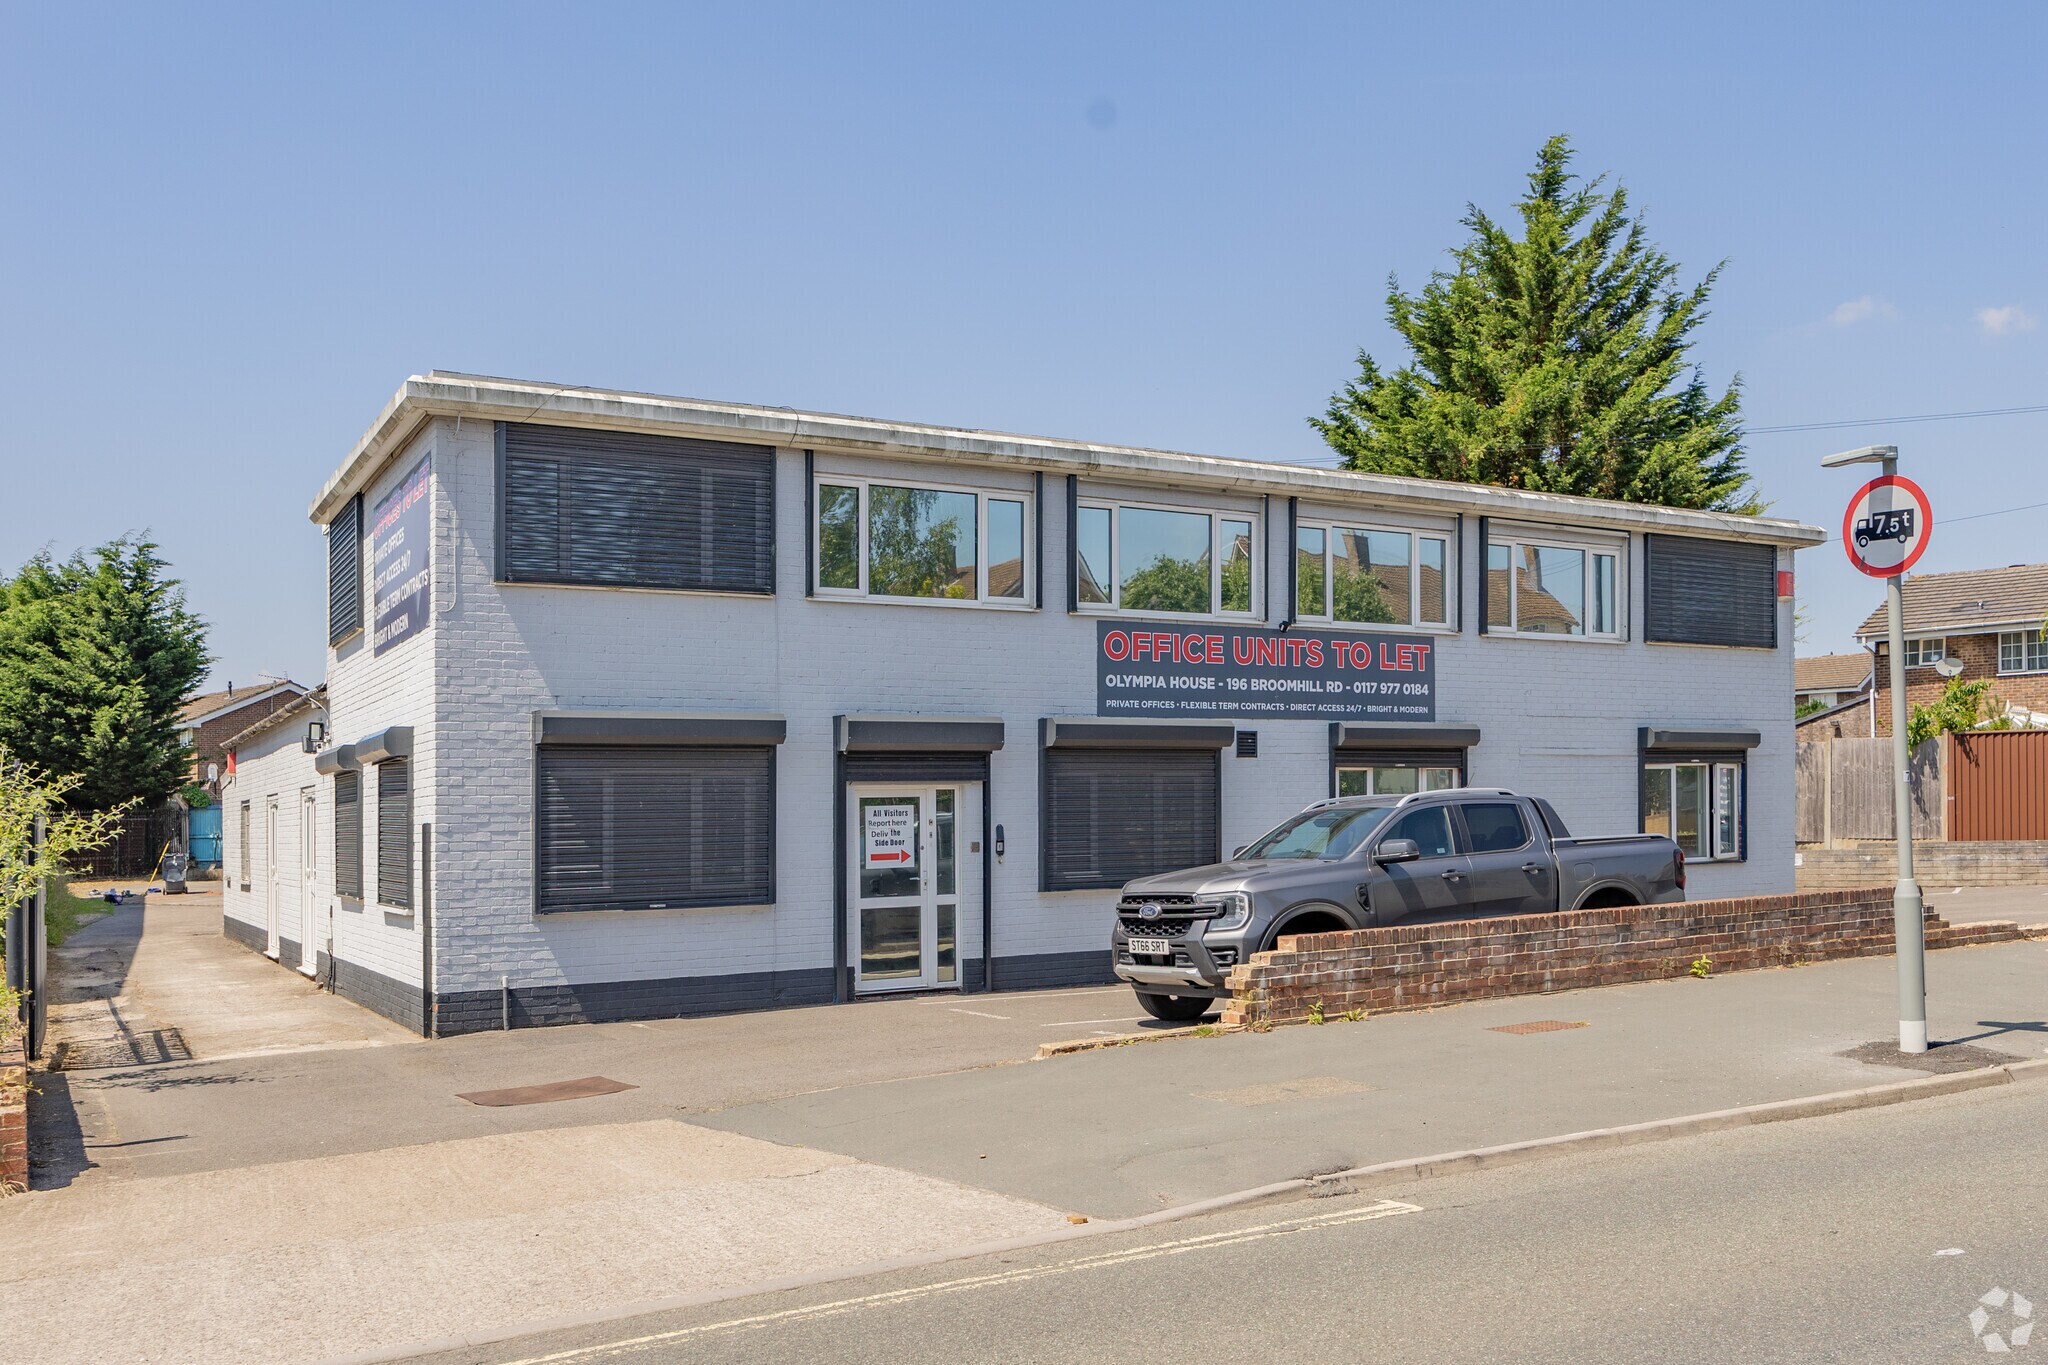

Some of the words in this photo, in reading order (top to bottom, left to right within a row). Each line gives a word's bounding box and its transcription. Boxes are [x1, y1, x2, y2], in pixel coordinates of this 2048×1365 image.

[388, 526, 404, 553] OFFICES
[386, 558, 400, 584] ACCESS
[401, 549, 411, 572] 24/7
[390, 587, 400, 609] TERM
[400, 568, 429, 601] CONTRACTS
[391, 612, 409, 639] MODERN
[1103, 630, 1224, 664] OFFICE
[1232, 635, 1324, 668] UNITS
[1331, 640, 1372, 669] TO
[1379, 642, 1430, 671] LET
[1105, 674, 1166, 689] OLYMPIA
[1169, 675, 1215, 690] HOUSE
[1226, 677, 1247, 691] 196
[1250, 678, 1323, 693] BROOMHILL
[1326, 680, 1342, 693] RD
[1353, 681, 1376, 694] 0117
[1380, 682, 1400, 694] 977
[1403, 682, 1428, 695] 0184
[1105, 699, 1139, 708] PRIVATE
[1141, 700, 1174, 709] OFFICES
[1181, 700, 1216, 709] FLEXIBLE
[1218, 701, 1238, 710] TERM
[1240, 702, 1284, 711] CONTRACTS
[1290, 703, 1316, 711] DIRECT
[1318, 703, 1344, 712] ACCESS
[1345, 704, 1361, 712] 24/7
[1367, 704, 1392, 712] BRIGHT
[1393, 705, 1397, 713] &
[1399, 705, 1428, 713] MODERN
[868, 820, 890, 828] Report
[871, 830, 888, 838] Deliv
[890, 829, 901, 837] the
[874, 839, 889, 847] Side
[1131, 940, 1150, 952] ST66
[1150, 941, 1166, 953] SRT
